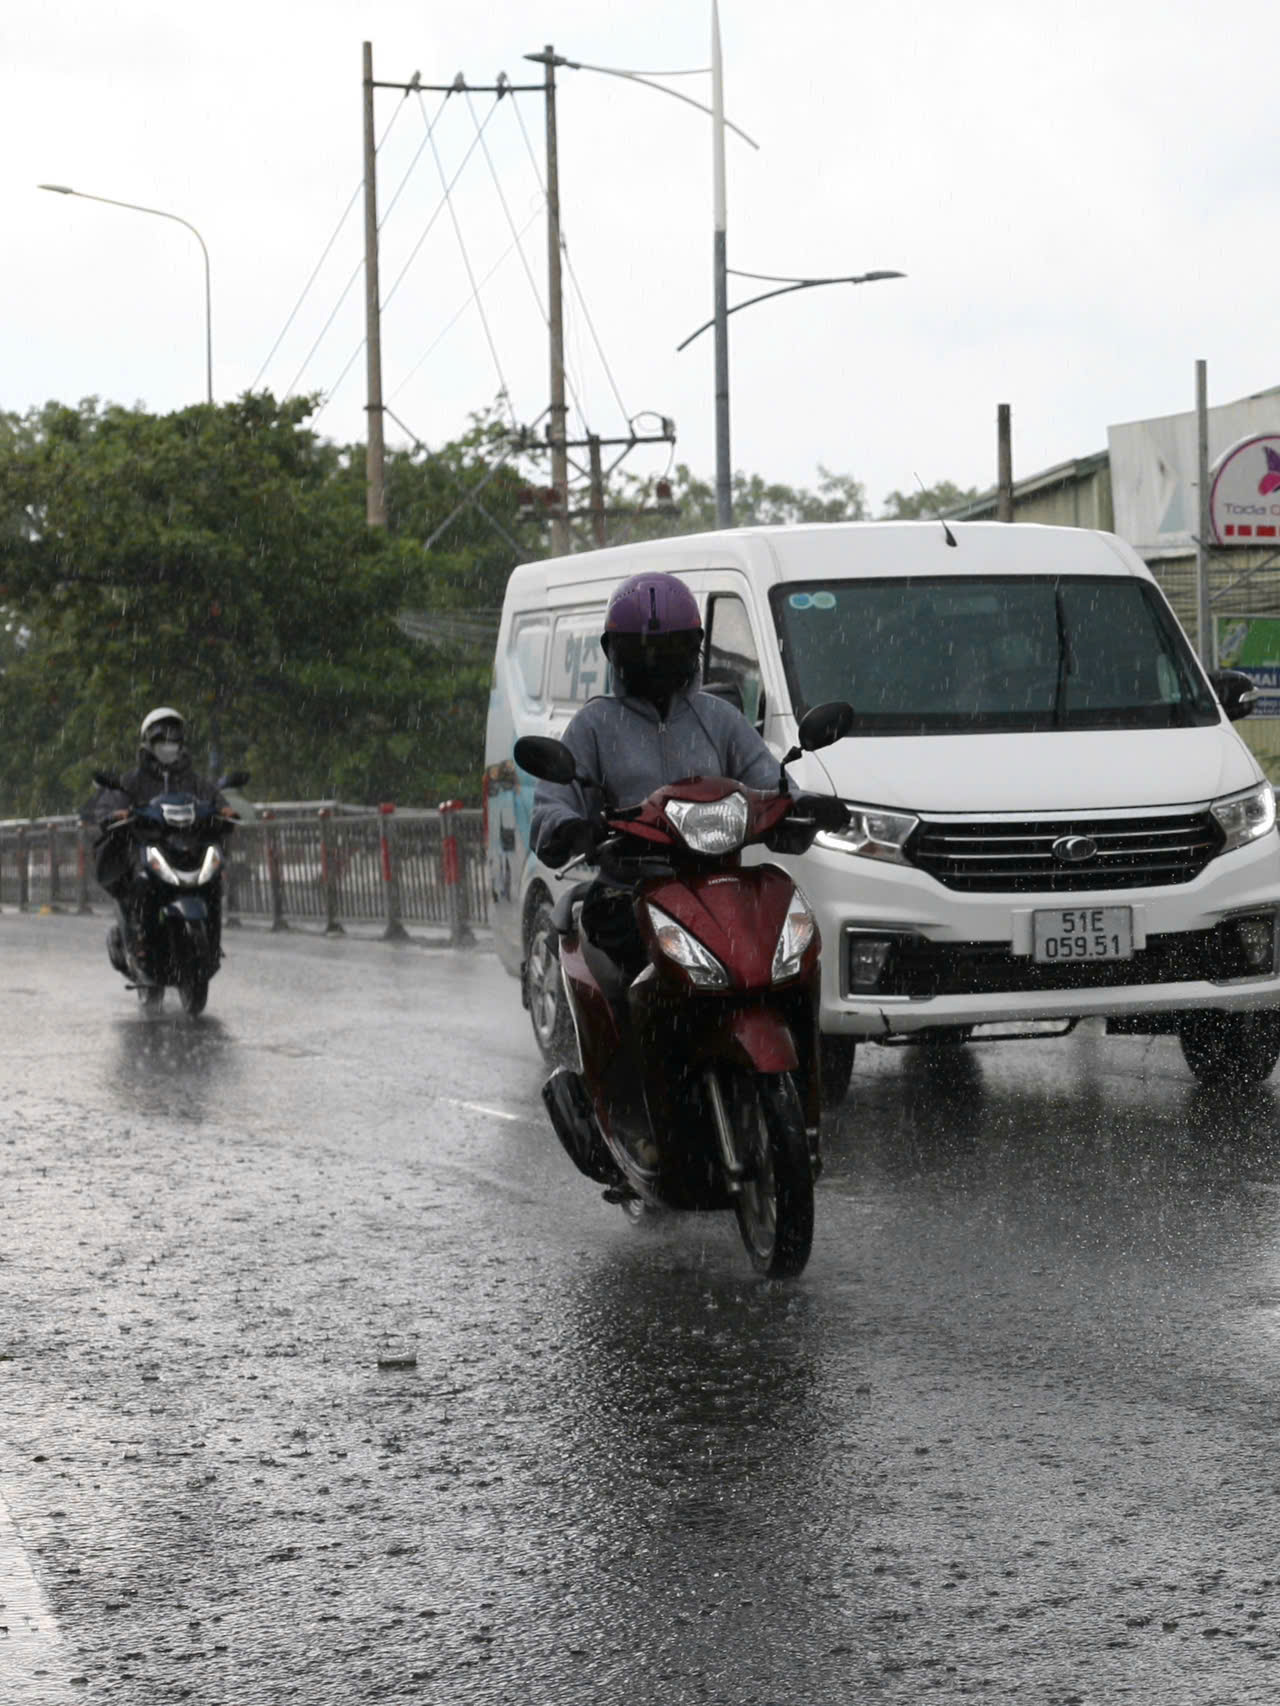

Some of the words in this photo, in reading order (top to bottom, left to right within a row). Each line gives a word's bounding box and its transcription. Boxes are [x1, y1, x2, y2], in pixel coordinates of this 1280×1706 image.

[1224, 503, 1266, 515] Toda
[1062, 911, 1104, 933] 51E
[1046, 934, 1119, 958] 059.51
